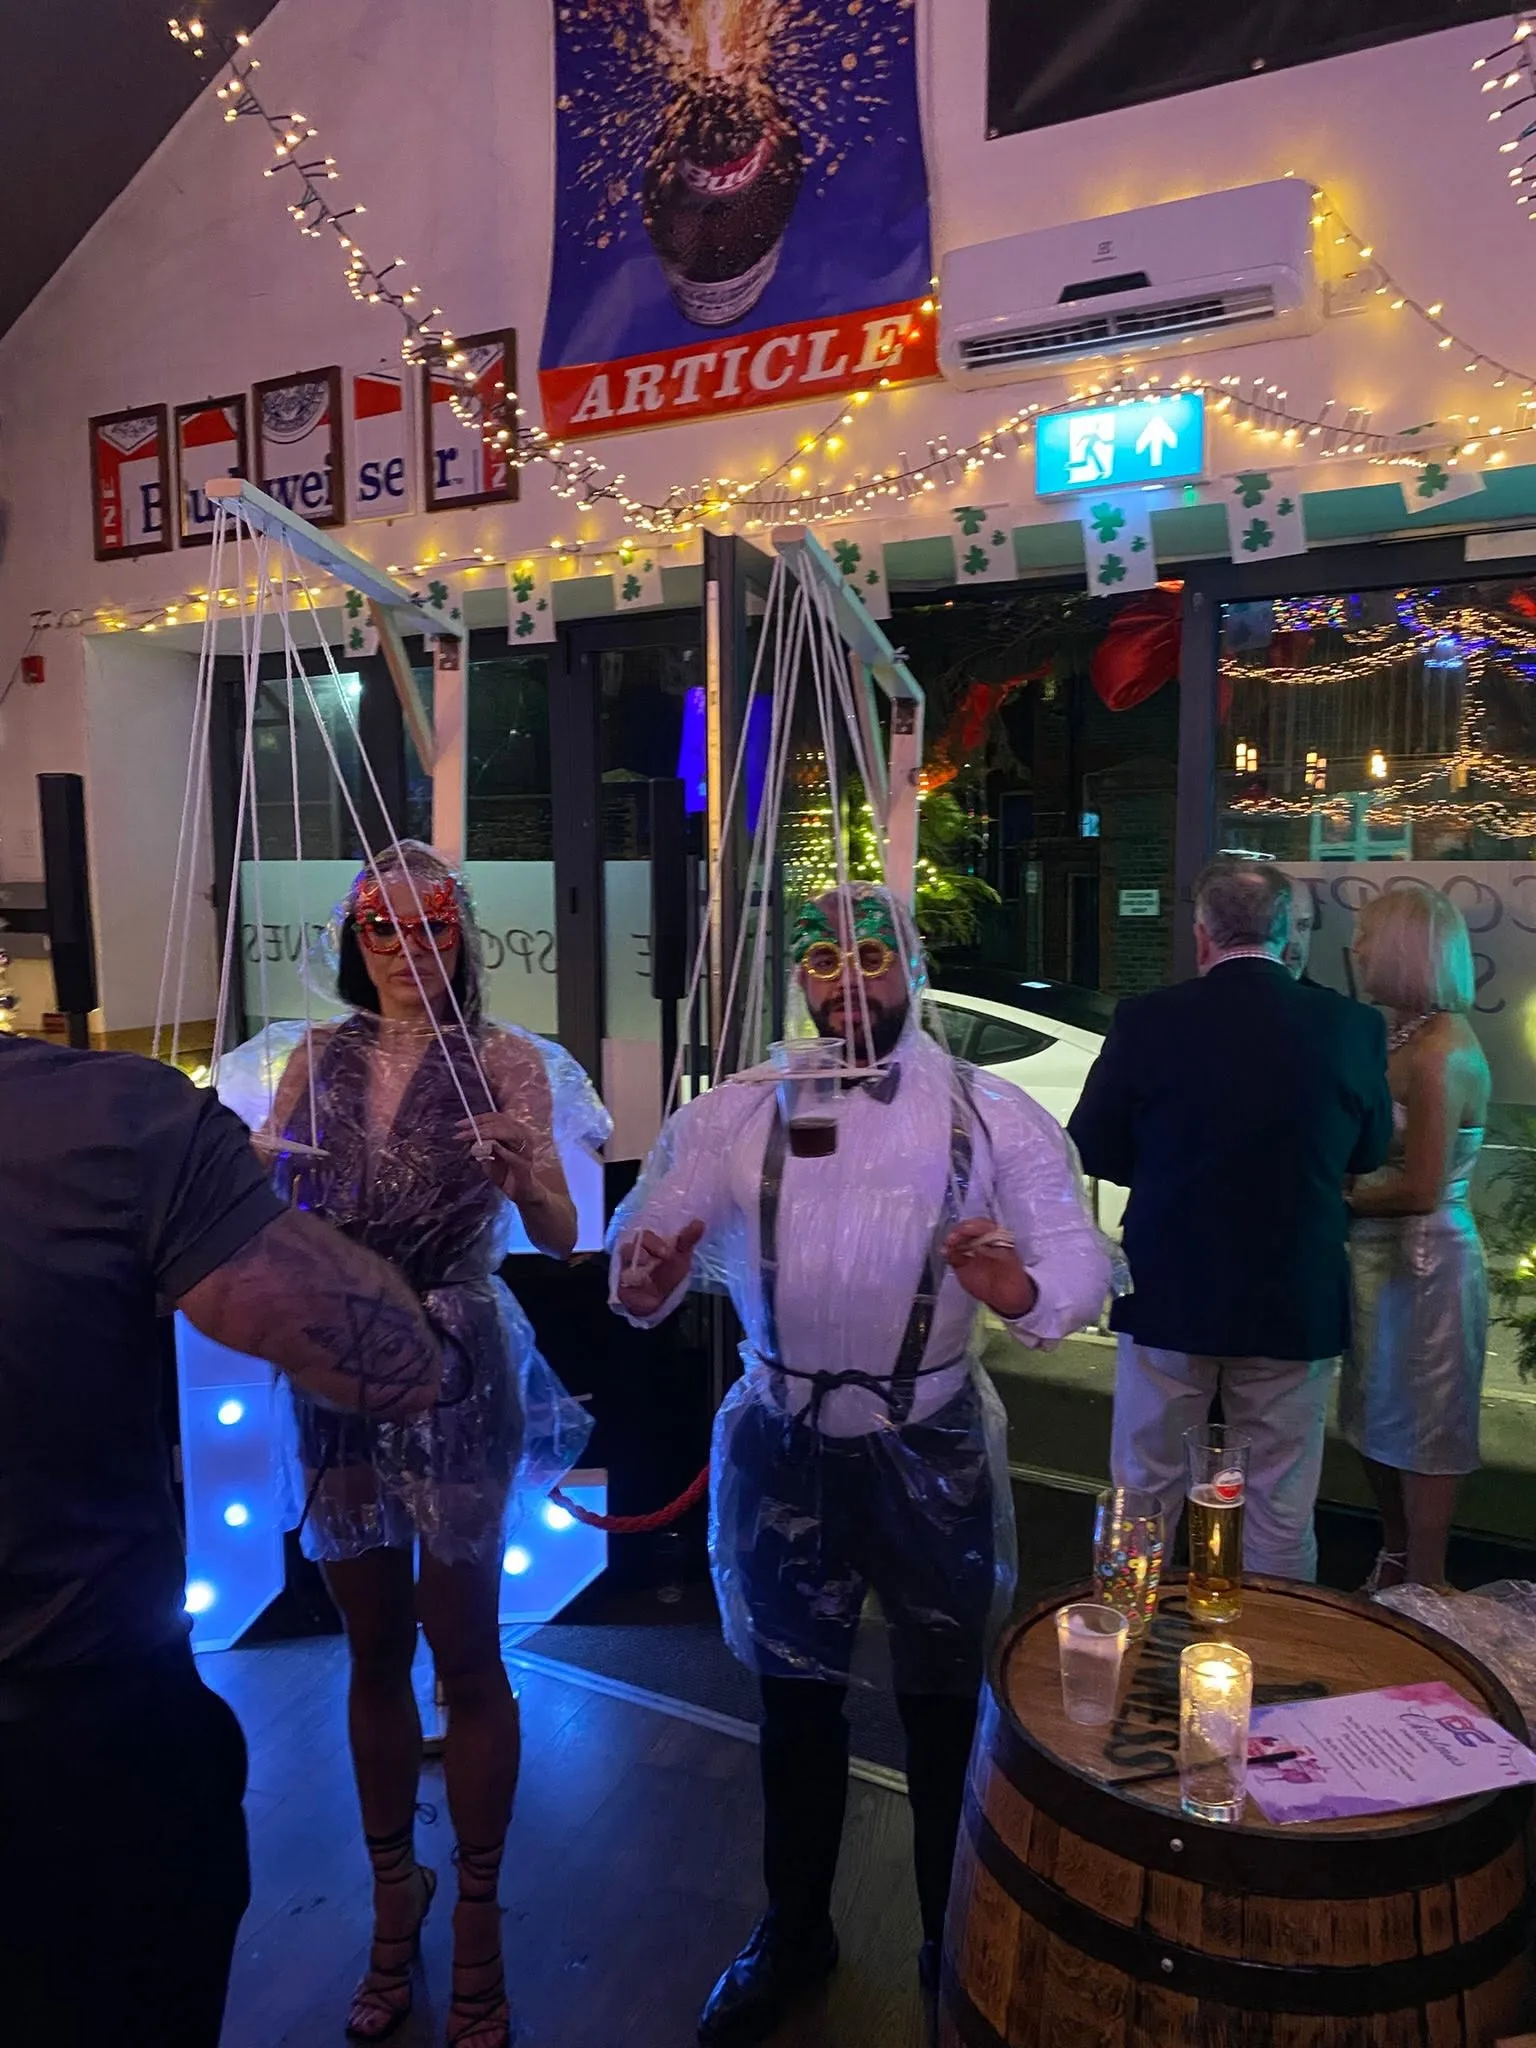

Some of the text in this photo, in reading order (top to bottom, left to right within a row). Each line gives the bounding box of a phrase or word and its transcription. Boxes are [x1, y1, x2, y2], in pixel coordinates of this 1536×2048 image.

[569, 314, 913, 425] ARTICLE
[140, 446, 458, 534] Buweiser
[1398, 1706, 1468, 1768] Christmas
